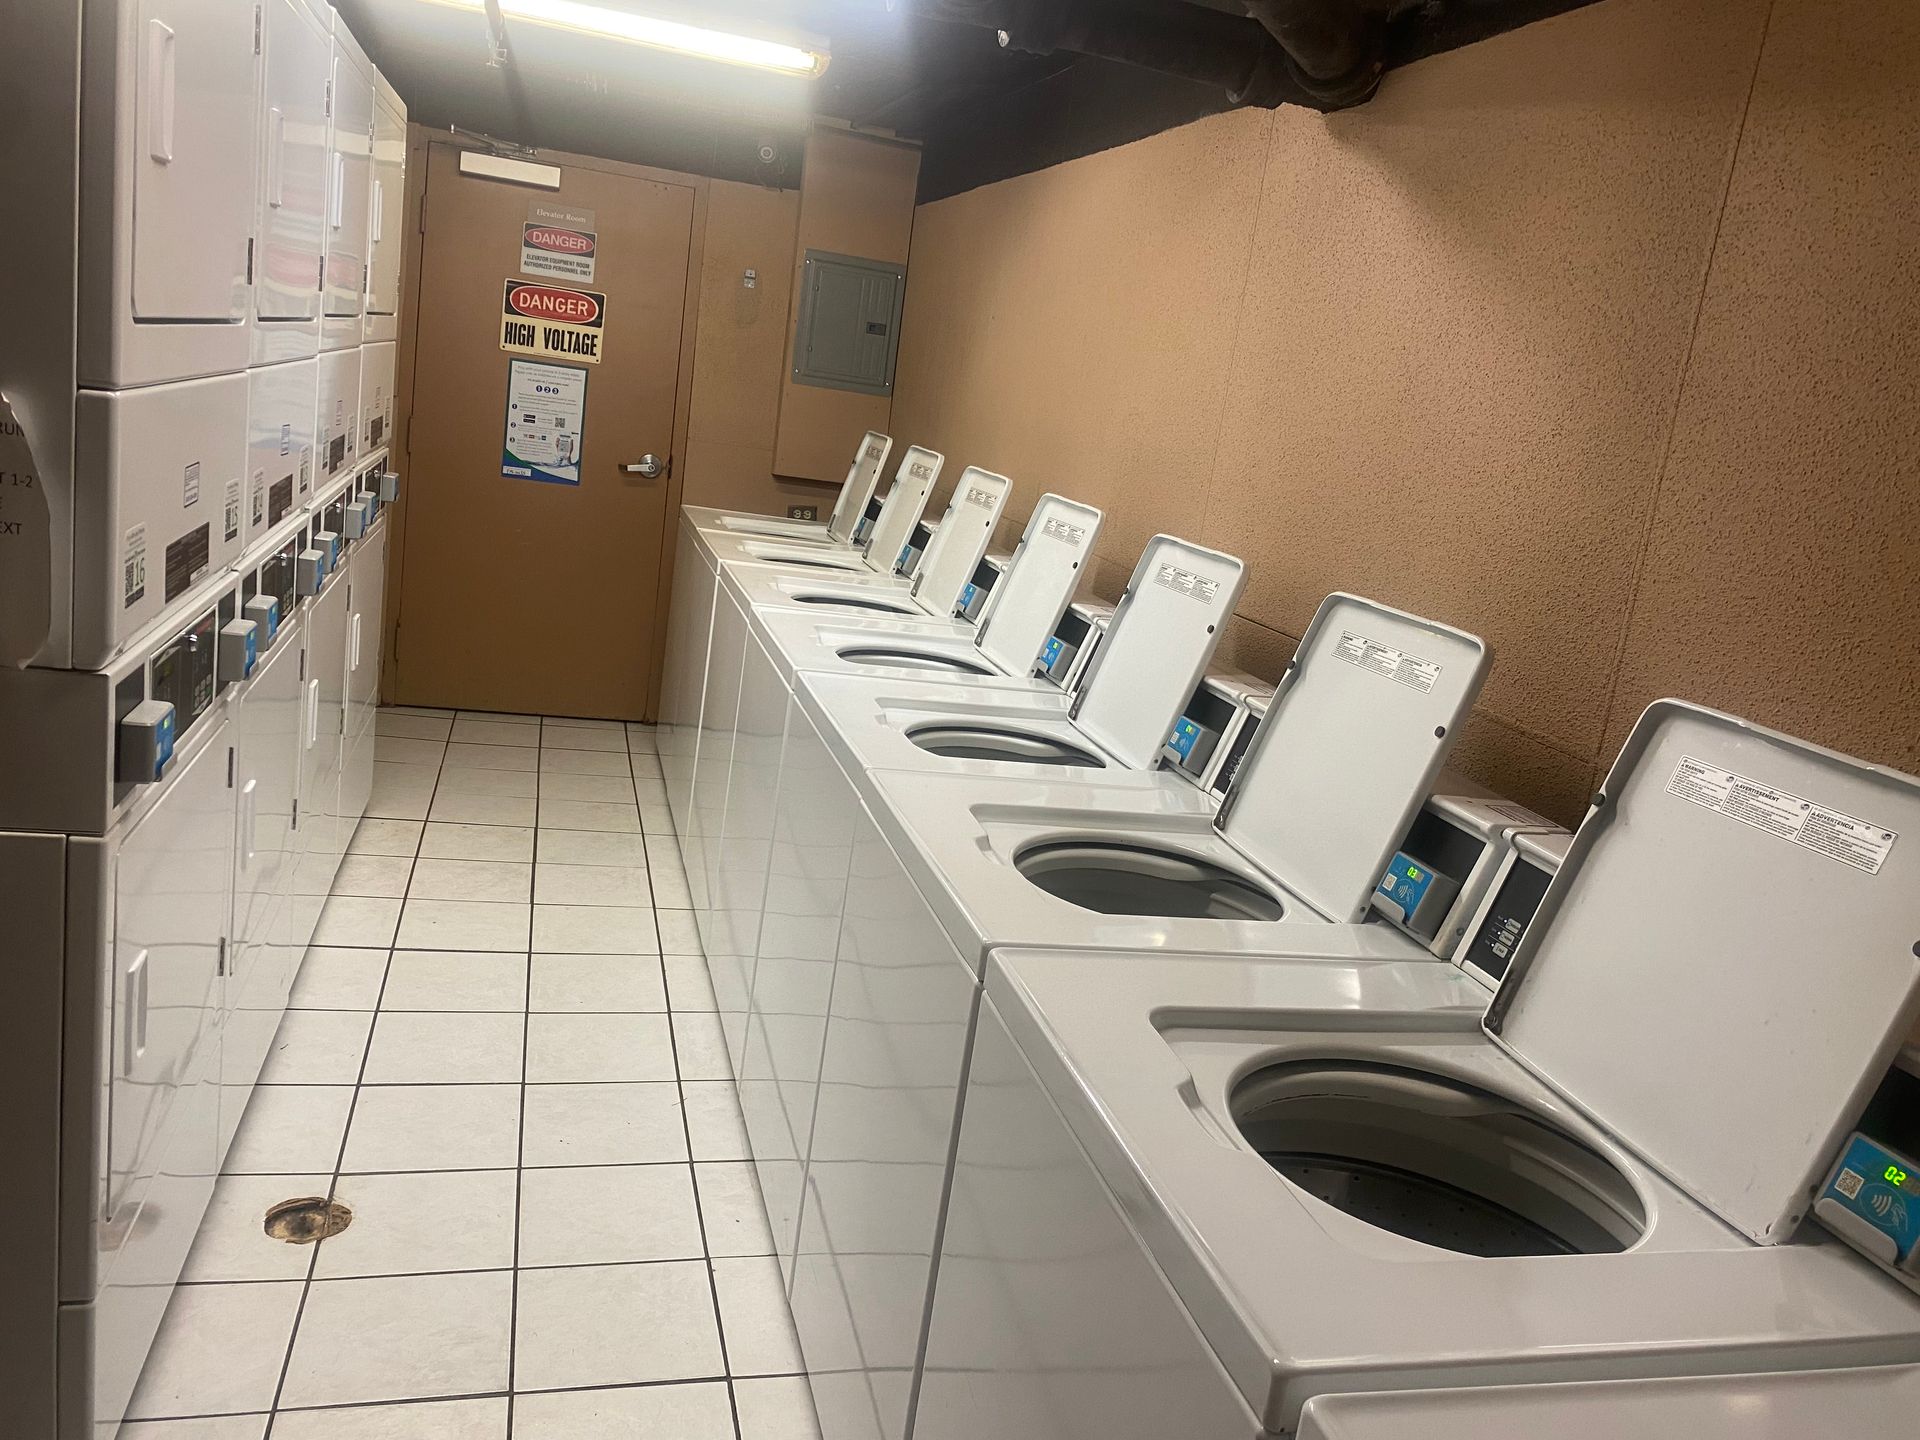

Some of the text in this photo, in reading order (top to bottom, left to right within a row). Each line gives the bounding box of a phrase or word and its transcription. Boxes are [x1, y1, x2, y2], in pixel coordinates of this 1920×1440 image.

[536, 208, 586, 223] Elevator Room
[532, 232, 587, 250] DANGER
[524, 260, 552, 270] AUTHORIZED
[553, 265, 578, 275] PERSONNEL
[526, 254, 549, 262] ELEVATOR
[550, 257, 575, 266] EQUIPMENT
[520, 292, 588, 316] DANGER
[504, 322, 598, 356] HIGH VOLTAGE
[12, 474, 33, 488] 1-2
[0, 522, 22, 535] XT
[134, 557, 145, 586] 16
[1738, 783, 1779, 803] AVERTISSEMENT
[1816, 812, 1855, 831] ADVERTENCIA
[1407, 866, 1417, 878] 03
[1884, 1166, 1907, 1186] 02
